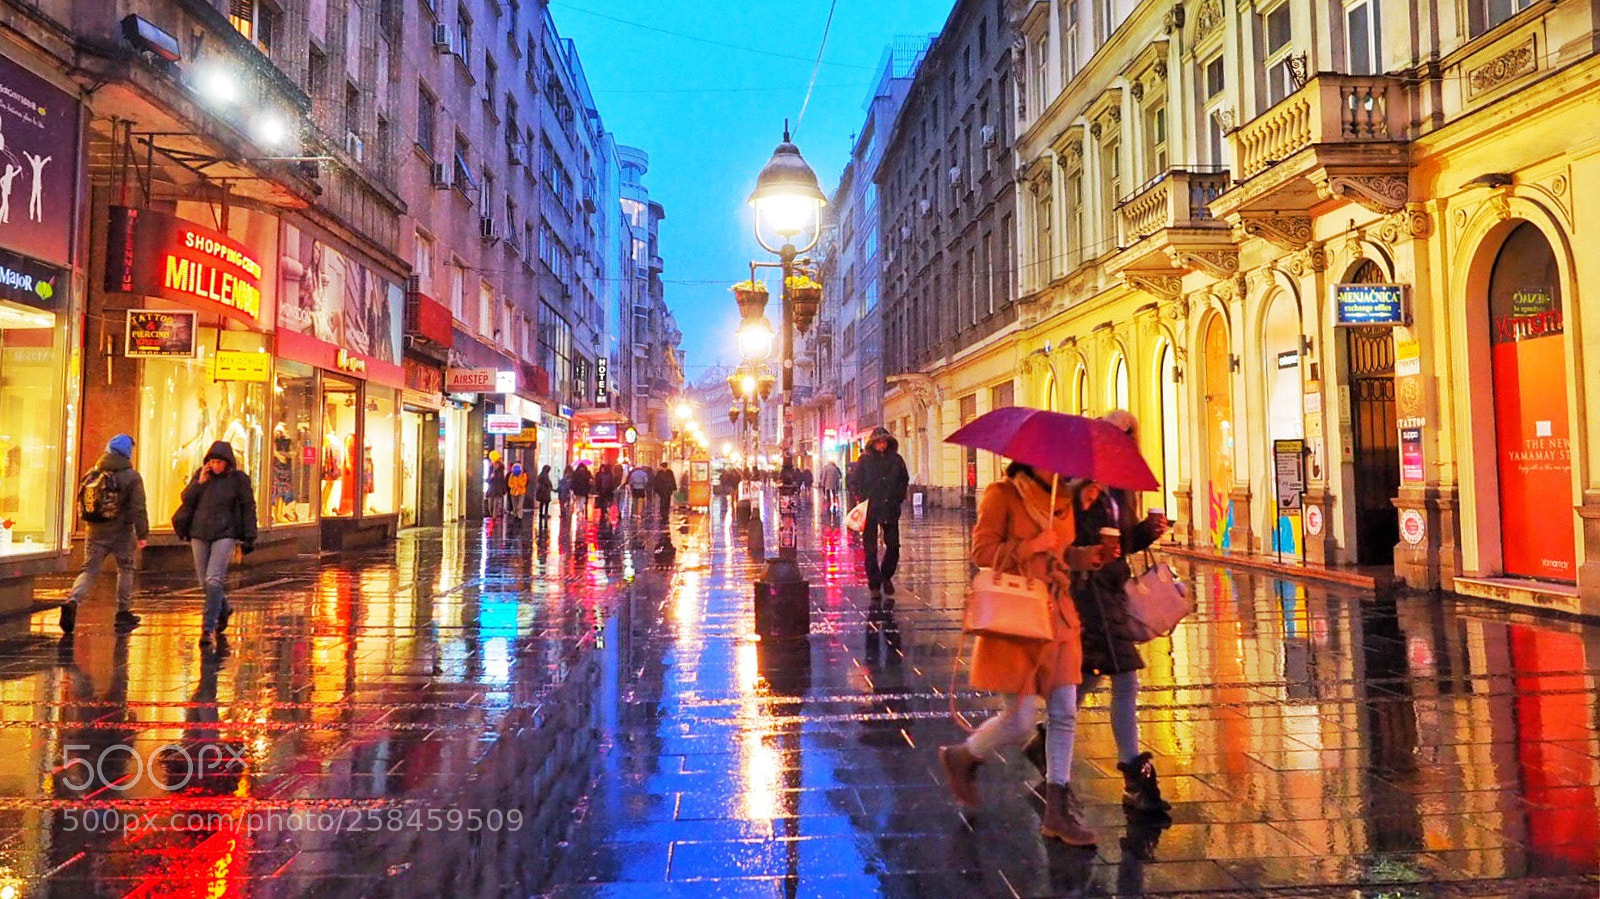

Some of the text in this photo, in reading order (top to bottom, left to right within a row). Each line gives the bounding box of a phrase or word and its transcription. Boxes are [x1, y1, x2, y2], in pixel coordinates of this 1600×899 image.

[184, 231, 243, 267] SHOPPING
[1339, 289, 1399, 303] MENJAČNICA
[1344, 303, 1393, 313] exchange office
[130, 313, 174, 325] TATTOO
[132, 330, 172, 338] PIERCING
[453, 374, 489, 385] AIRSTEP
[598, 358, 607, 396] HOTEL
[1398, 417, 1426, 428] TATTOO
[1526, 439, 1545, 450] THE
[1508, 450, 1556, 461] YAMAMAY
